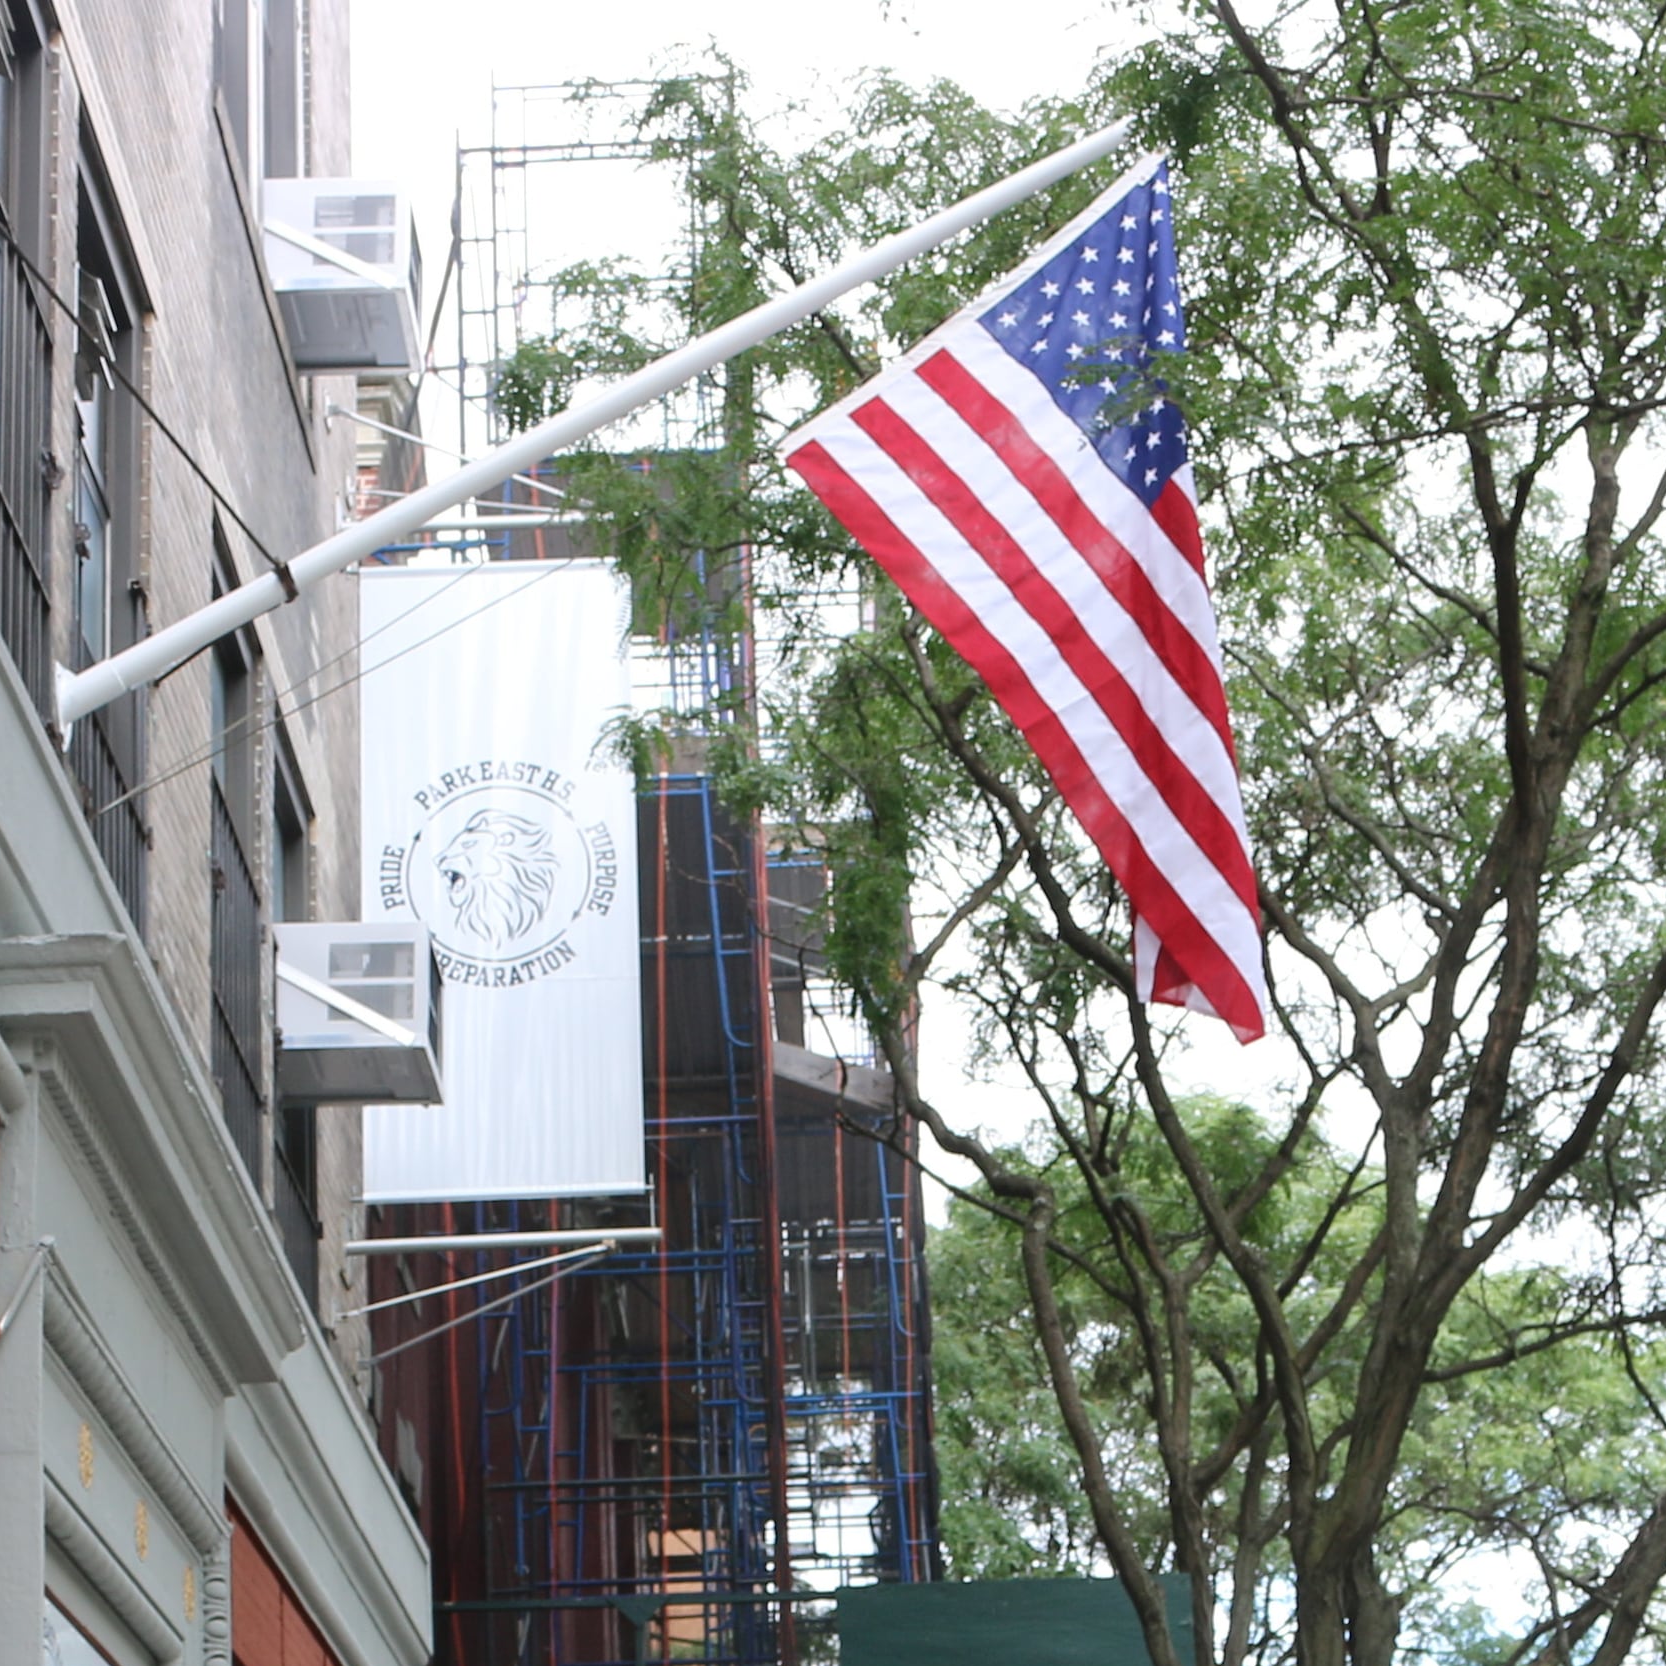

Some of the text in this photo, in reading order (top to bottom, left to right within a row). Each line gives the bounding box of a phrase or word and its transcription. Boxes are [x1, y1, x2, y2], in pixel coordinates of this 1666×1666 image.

[414, 765, 477, 810] PARK
[480, 760, 542, 784] EAST
[380, 845, 406, 911] PRIDE
[585, 821, 617, 917] PURPOSE
[435, 939, 576, 987] REPARATION
